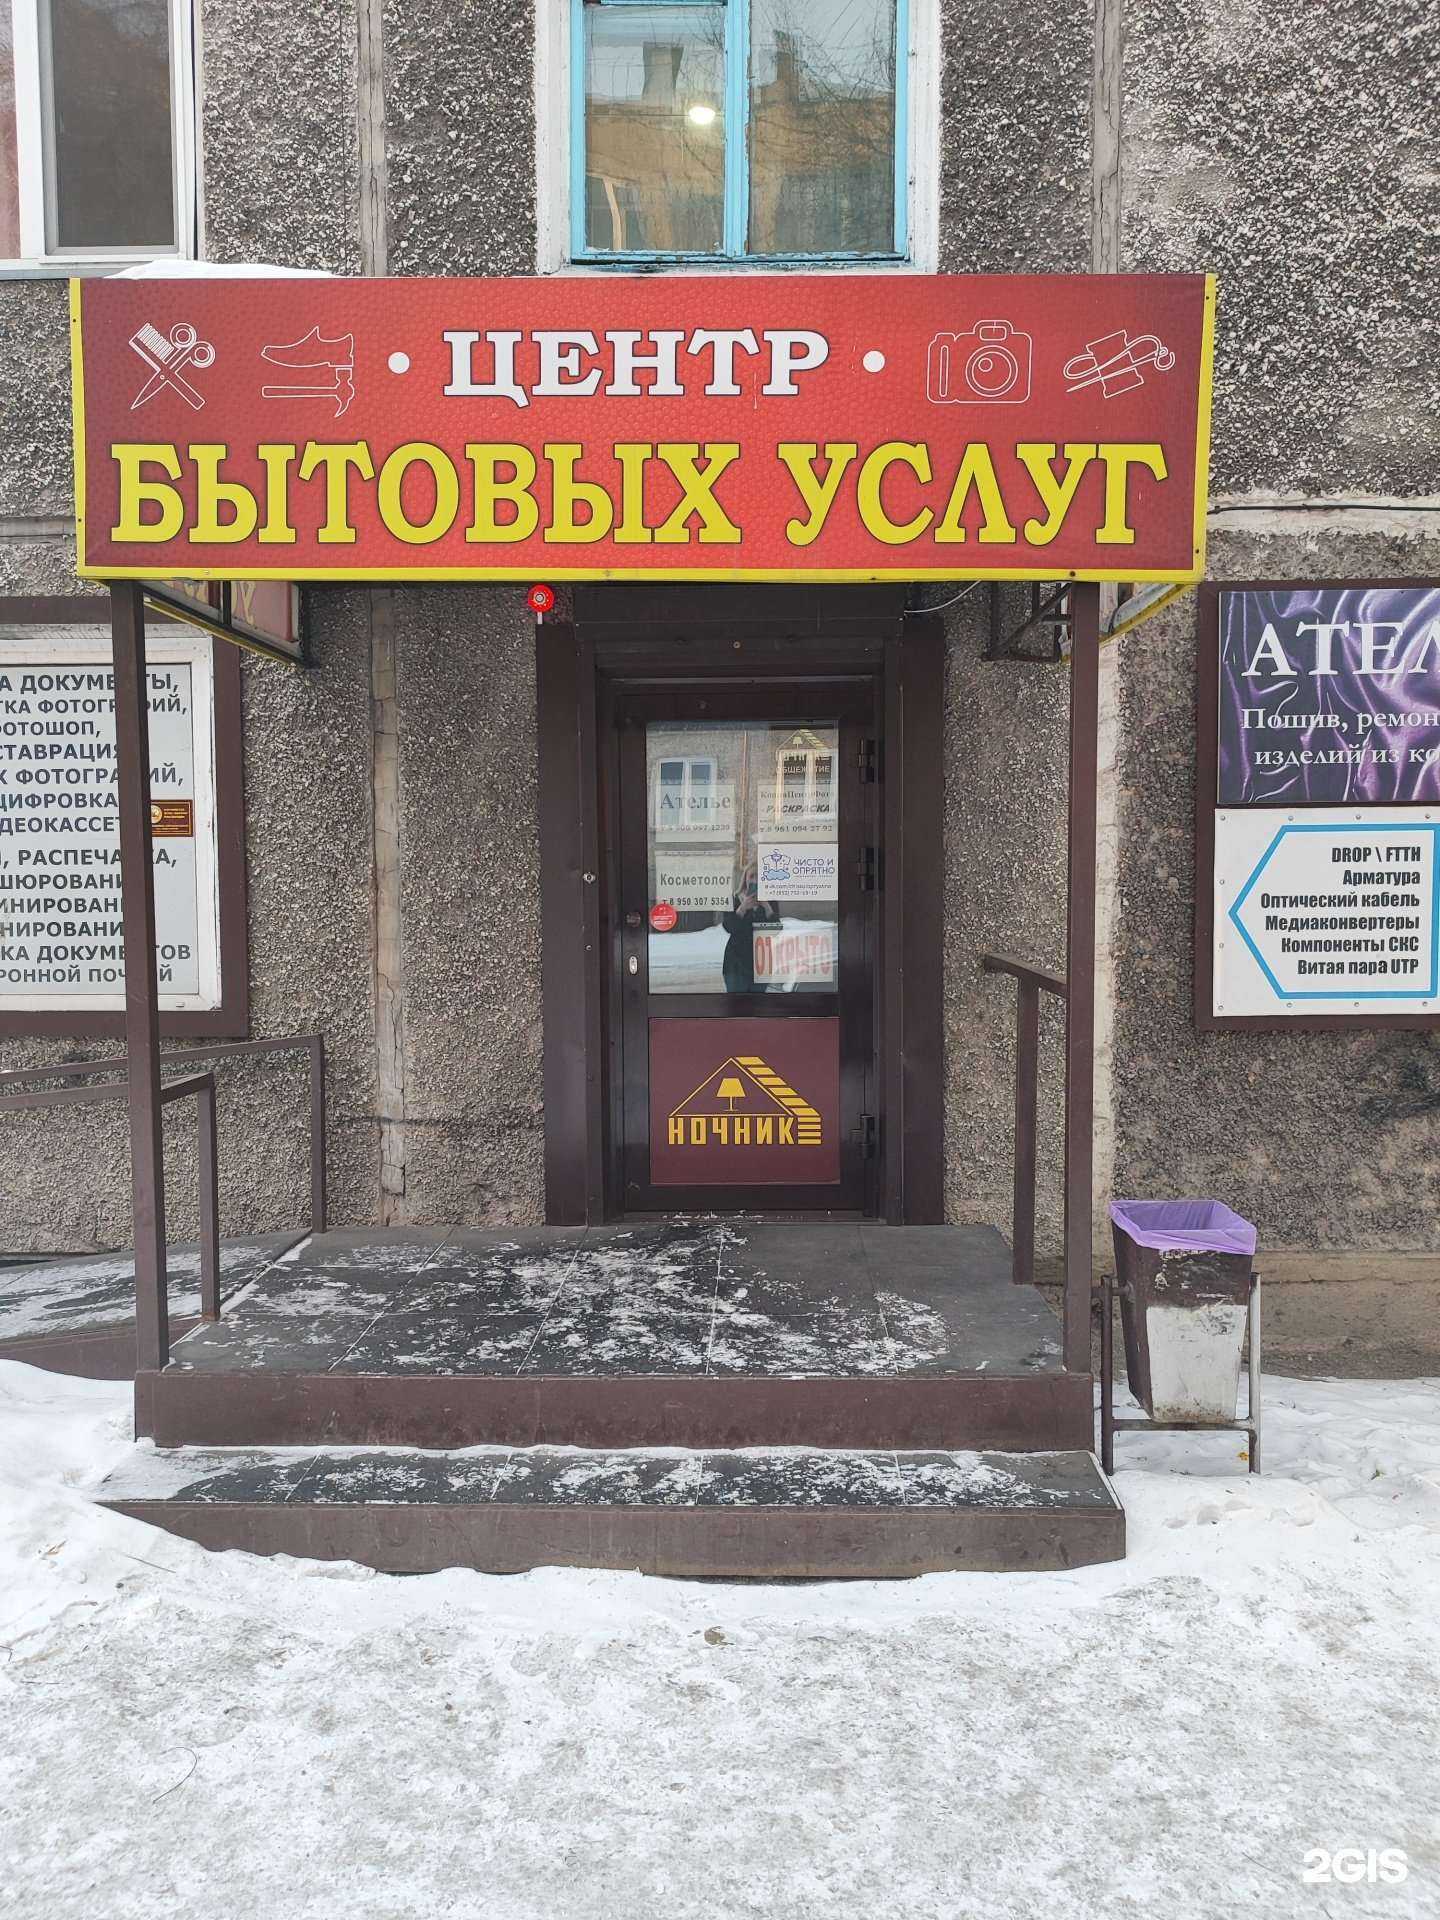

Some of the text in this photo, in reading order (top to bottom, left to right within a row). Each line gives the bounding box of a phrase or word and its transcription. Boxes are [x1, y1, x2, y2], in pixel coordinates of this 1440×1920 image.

[442, 328, 830, 408] ЦЕНТР
[110, 441, 1169, 546] БЫТОВЫХ УСЛУГ
[20, 673, 179, 694] ДОКУМЕЫ,
[0, 693, 187, 715] КА ФОТОГИЙ,
[0, 721, 101, 738] ОТОШОП,
[1241, 708, 1440, 735] Пошив, ремон
[1255, 743, 1362, 767] изделий
[1371, 748, 1400, 764] из
[15, 762, 184, 786] ФОТОГРАИЙ,
[660, 792, 731, 809] Ателье
[0, 817, 120, 836] ДЕОКАССЕ
[18, 848, 177, 868] РАСПЕЧАА,
[794, 858, 834, 867] ЧИСТО И
[1331, 847, 1372, 863] DROP
[1386, 846, 1421, 862] FTTH
[660, 873, 731, 886] Косметолог
[792, 866, 836, 875] ОПРЯТНО
[1343, 869, 1421, 887] Арматура
[0, 873, 122, 890] ШЮРОВАН
[677, 897, 691, 906] 950
[710, 897, 729, 906] 5354
[1261, 891, 1420, 909] Оптический кабель
[0, 921, 125, 938] НИРОВАНИ
[1265, 915, 1420, 933] Медиаконвертеры
[1281, 936, 1419, 953] Компоненты СКС
[36, 944, 191, 964] ДОКУМЕОВ
[755, 935, 832, 976] ОТКРЫТО
[1297, 958, 1419, 976] Витая пара UTP
[668, 1117, 795, 1145] НОЧНИК
